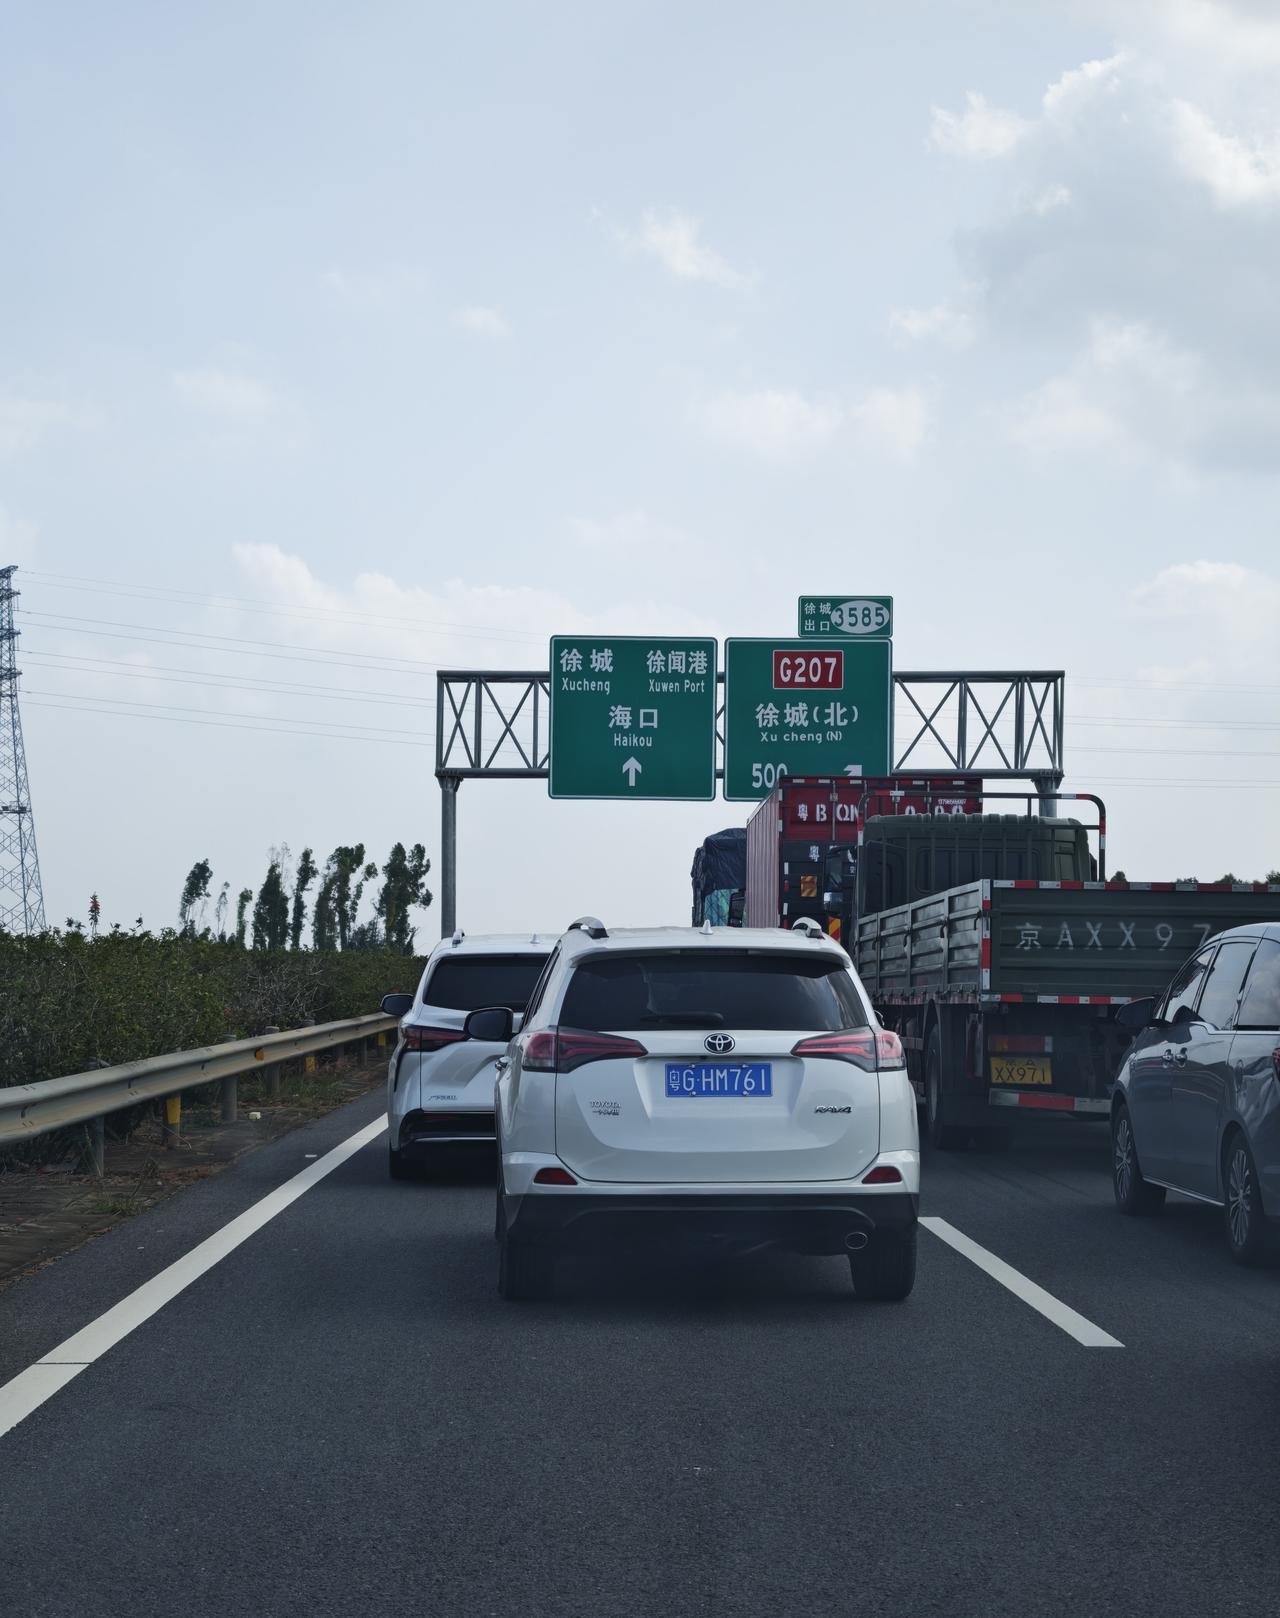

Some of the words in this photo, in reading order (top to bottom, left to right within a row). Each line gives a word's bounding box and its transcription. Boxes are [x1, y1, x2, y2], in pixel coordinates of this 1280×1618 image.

[804, 602, 831, 614] 徐城
[834, 606, 884, 627] 3585
[804, 619, 830, 632] 出口
[560, 648, 613, 672] 徐城
[646, 650, 708, 674] 徐闻港
[779, 657, 837, 683] G207
[561, 677, 611, 695] Xucheng
[649, 679, 680, 693] Xuwen
[684, 679, 705, 693] Port
[608, 705, 658, 729] 海口
[613, 733, 653, 747] Haikou
[994, 1066, 1046, 1082] XX971
